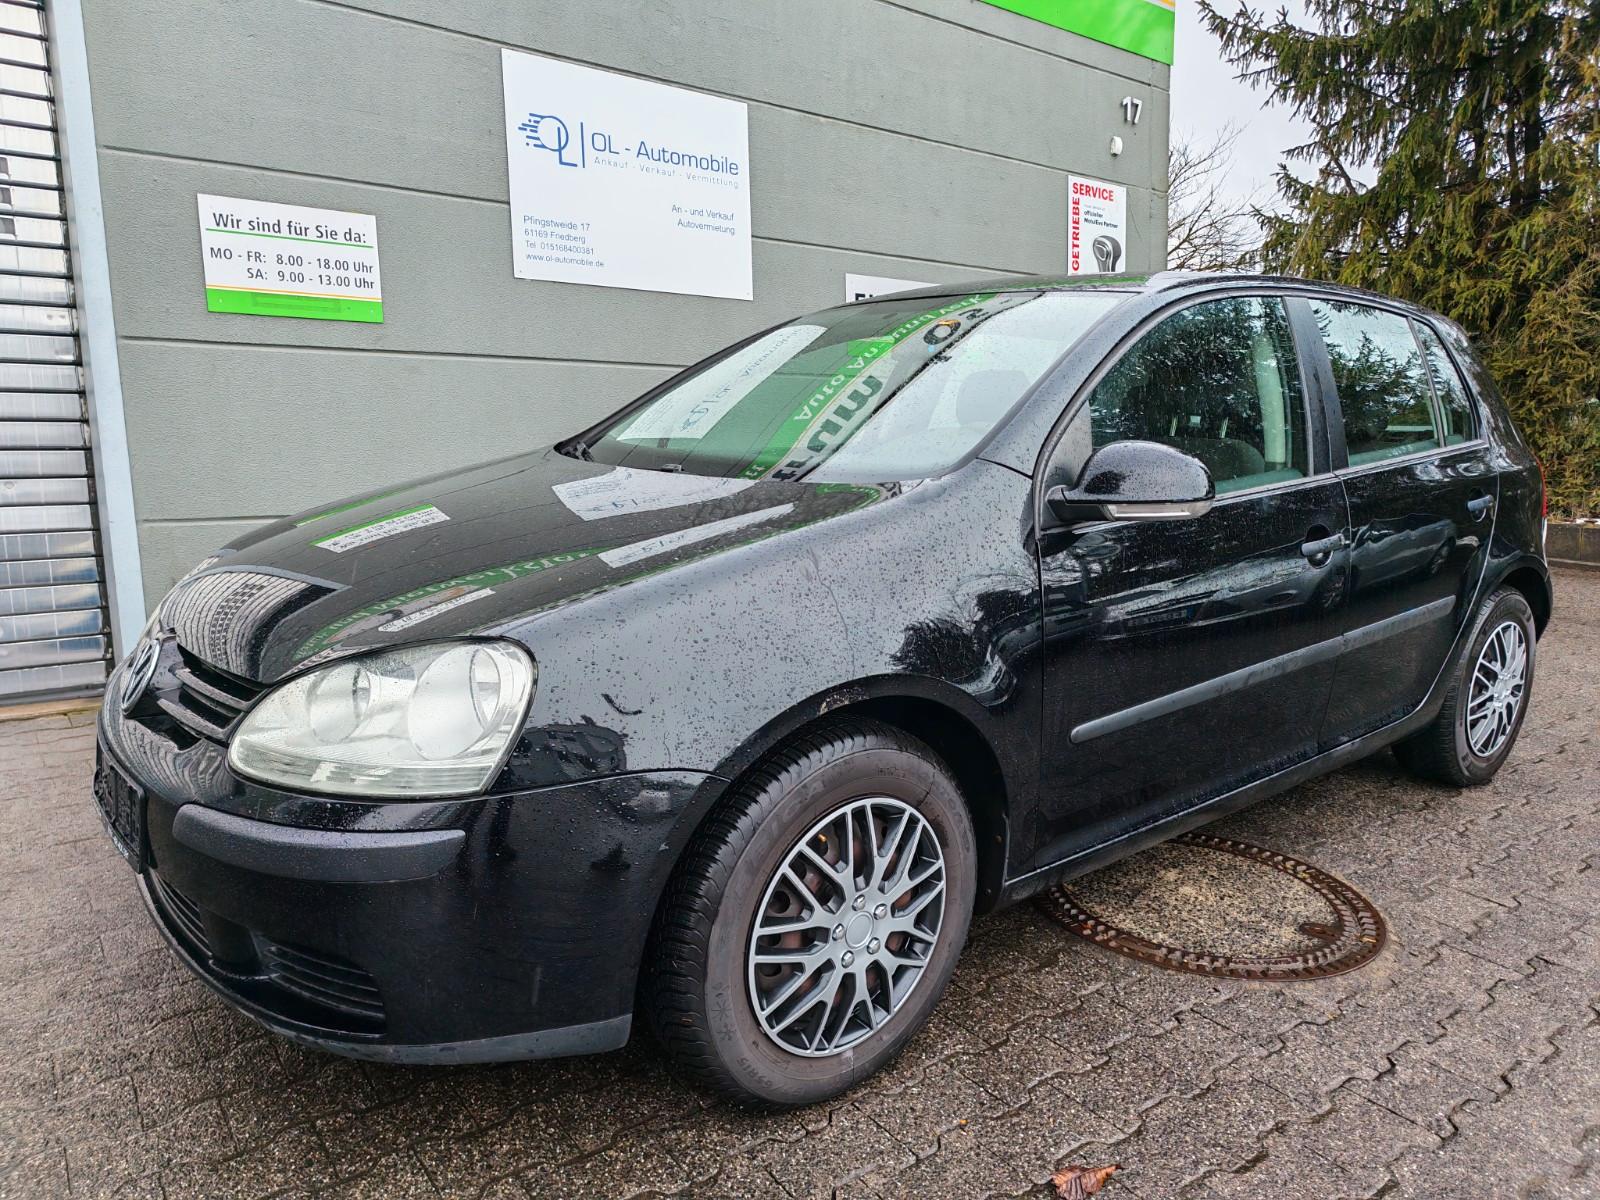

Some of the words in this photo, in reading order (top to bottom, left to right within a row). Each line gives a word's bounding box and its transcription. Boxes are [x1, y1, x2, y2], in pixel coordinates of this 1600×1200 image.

[1121, 96, 1142, 124] 17
[591, 132, 620, 154] OL
[636, 140, 739, 176] Automobile
[594, 156, 628, 168] Ankauf
[639, 164, 676, 177] Verkauf
[686, 172, 738, 189] Vermittlung
[1072, 182, 1114, 202] SERVICE
[523, 215, 578, 230] Pfingstweide
[581, 223, 590, 232] 17
[672, 204, 682, 214] An
[690, 208, 704, 217] und
[706, 209, 734, 221] Verkauf
[212, 212, 241, 229] Wir
[248, 217, 281, 233] sind
[287, 221, 309, 237] für
[316, 225, 338, 240] Sie
[344, 228, 366, 243] da:
[524, 228, 548, 238] 61169
[550, 232, 586, 244] Friedberg
[678, 218, 735, 236] Autovermietung
[210, 247, 232, 260] MO
[247, 251, 266, 263] FR:
[276, 254, 303, 267] 8.00
[317, 258, 349, 271] 18.00
[353, 261, 374, 274] Uhr
[247, 267, 268, 280] SA:
[277, 271, 304, 283] 9.00
[318, 275, 350, 287] 13.00
[355, 277, 374, 289] Uhr
